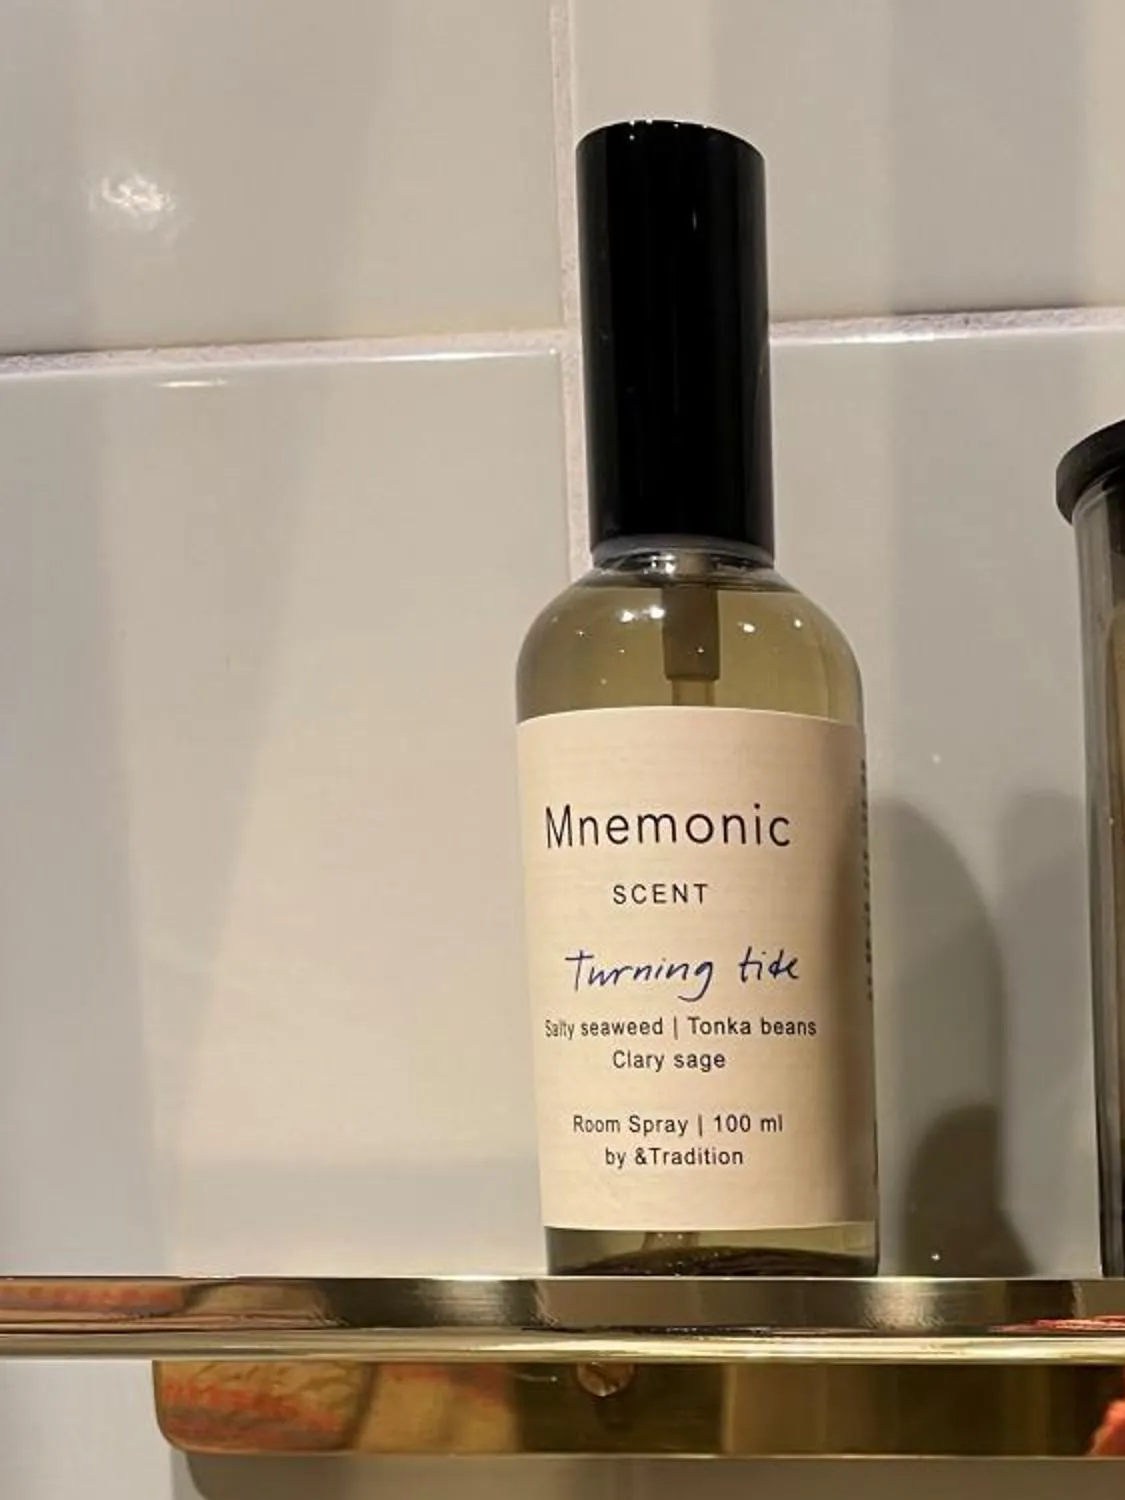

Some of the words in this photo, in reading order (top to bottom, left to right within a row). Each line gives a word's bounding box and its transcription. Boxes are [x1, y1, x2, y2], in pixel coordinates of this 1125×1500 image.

[546, 803, 790, 848] Mnemonic
[613, 883, 708, 905] SCENT
[565, 950, 713, 1003] Turning
[738, 946, 799, 983] tide
[545, 1019, 574, 1040] Salty
[580, 1017, 663, 1037] seaweed
[687, 1016, 752, 1035] Tonka
[759, 1017, 816, 1036] beans
[612, 1050, 665, 1072] Clary
[674, 1053, 726, 1072] sage
[573, 1115, 620, 1133] Room
[629, 1114, 688, 1138] Spray
[714, 1114, 751, 1133] 100
[759, 1115, 782, 1132] ml
[605, 1147, 626, 1169] by
[634, 1146, 743, 1165] &Tradition
